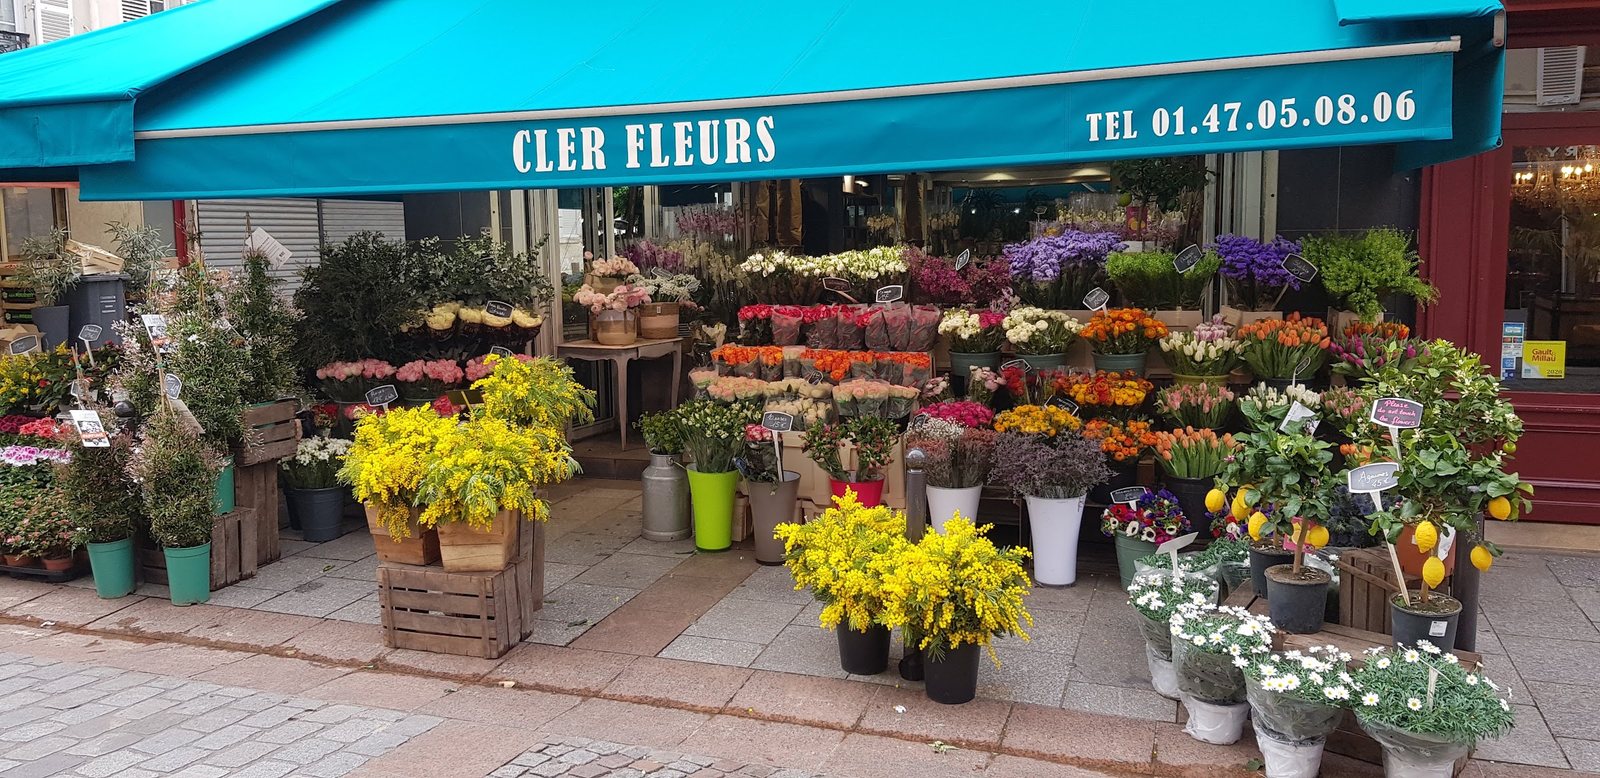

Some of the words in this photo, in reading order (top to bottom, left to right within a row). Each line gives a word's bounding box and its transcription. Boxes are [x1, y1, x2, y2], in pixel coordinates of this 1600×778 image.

[1085, 110, 1138, 142] TEL
[1151, 89, 1416, 138] 01.47.05.08.06
[512, 126, 607, 174] CLER
[625, 115, 776, 169] FLEURS
[1531, 354, 1556, 362] Millau
[1384, 400, 1409, 408] Please
[1391, 415, 1416, 426] flowers
